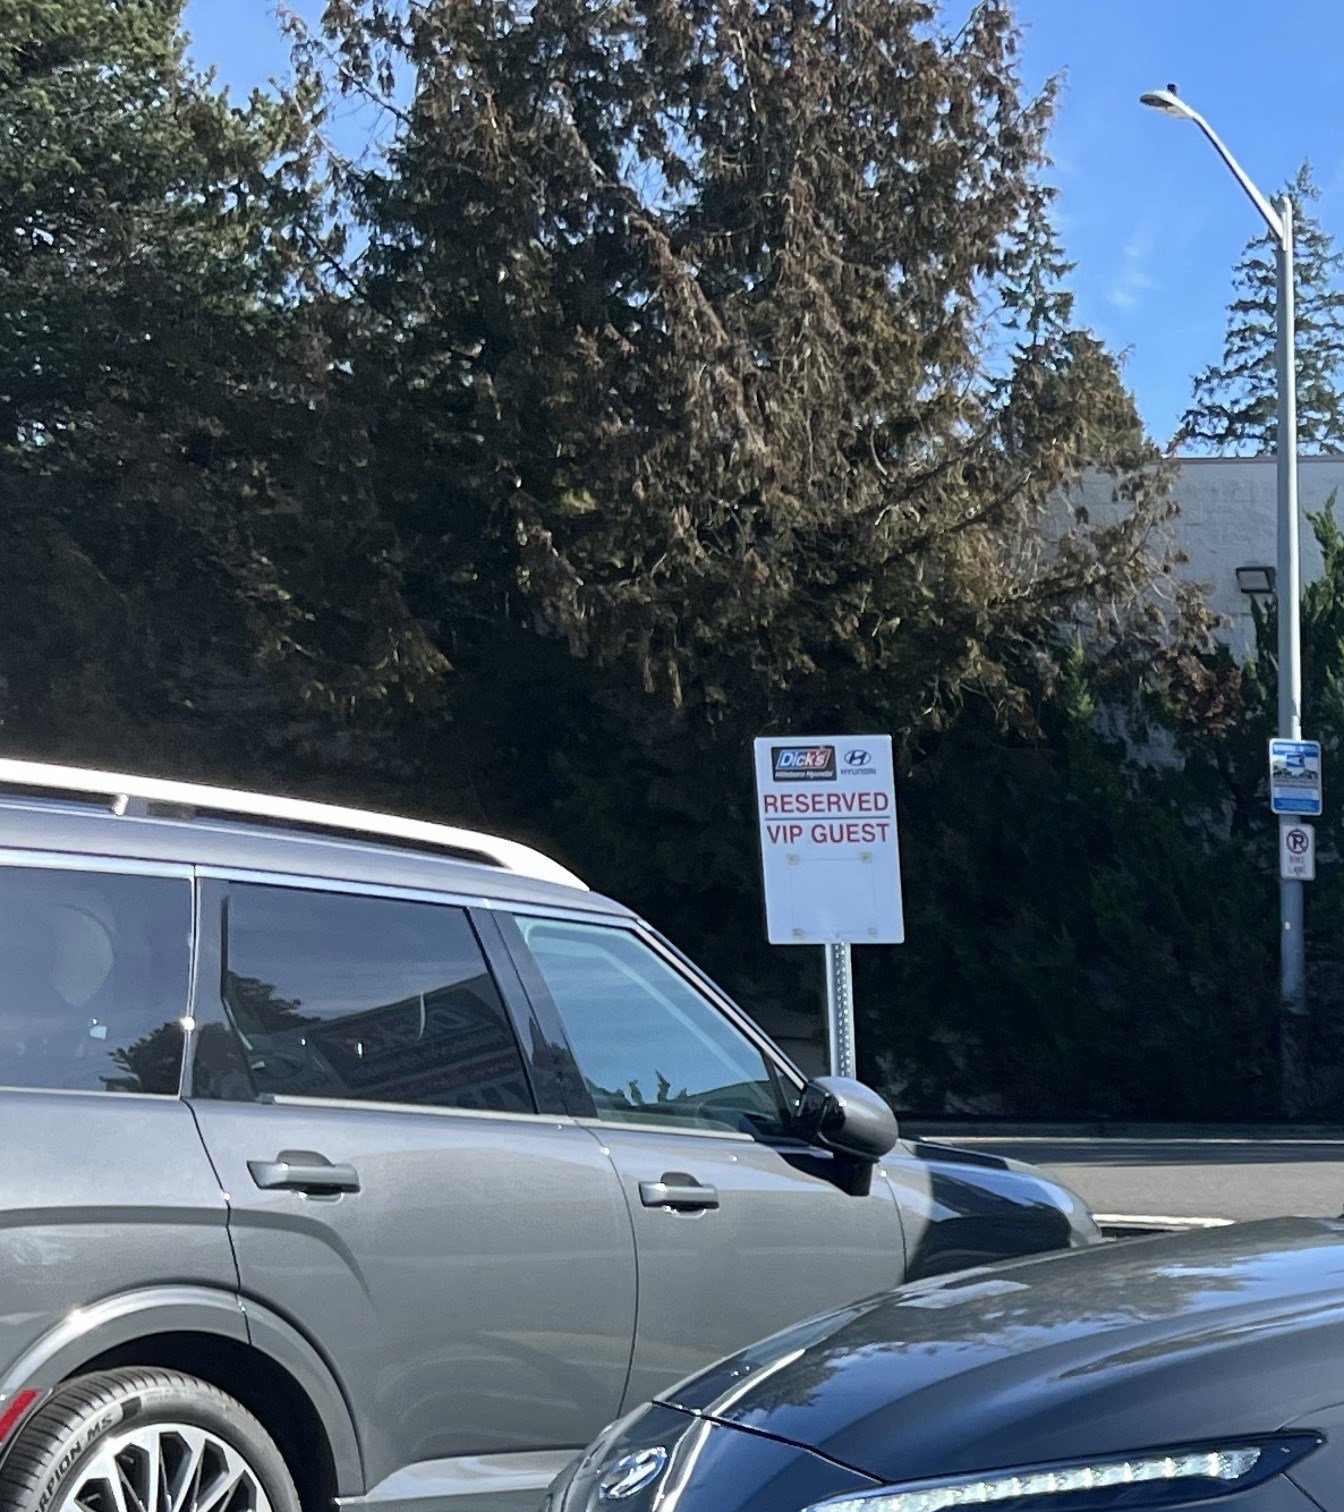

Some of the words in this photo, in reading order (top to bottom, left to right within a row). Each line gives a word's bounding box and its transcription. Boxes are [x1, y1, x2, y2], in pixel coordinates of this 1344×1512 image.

[763, 792, 889, 813] RESERVED
[766, 824, 803, 844] VIP
[811, 823, 890, 843] GUEST
